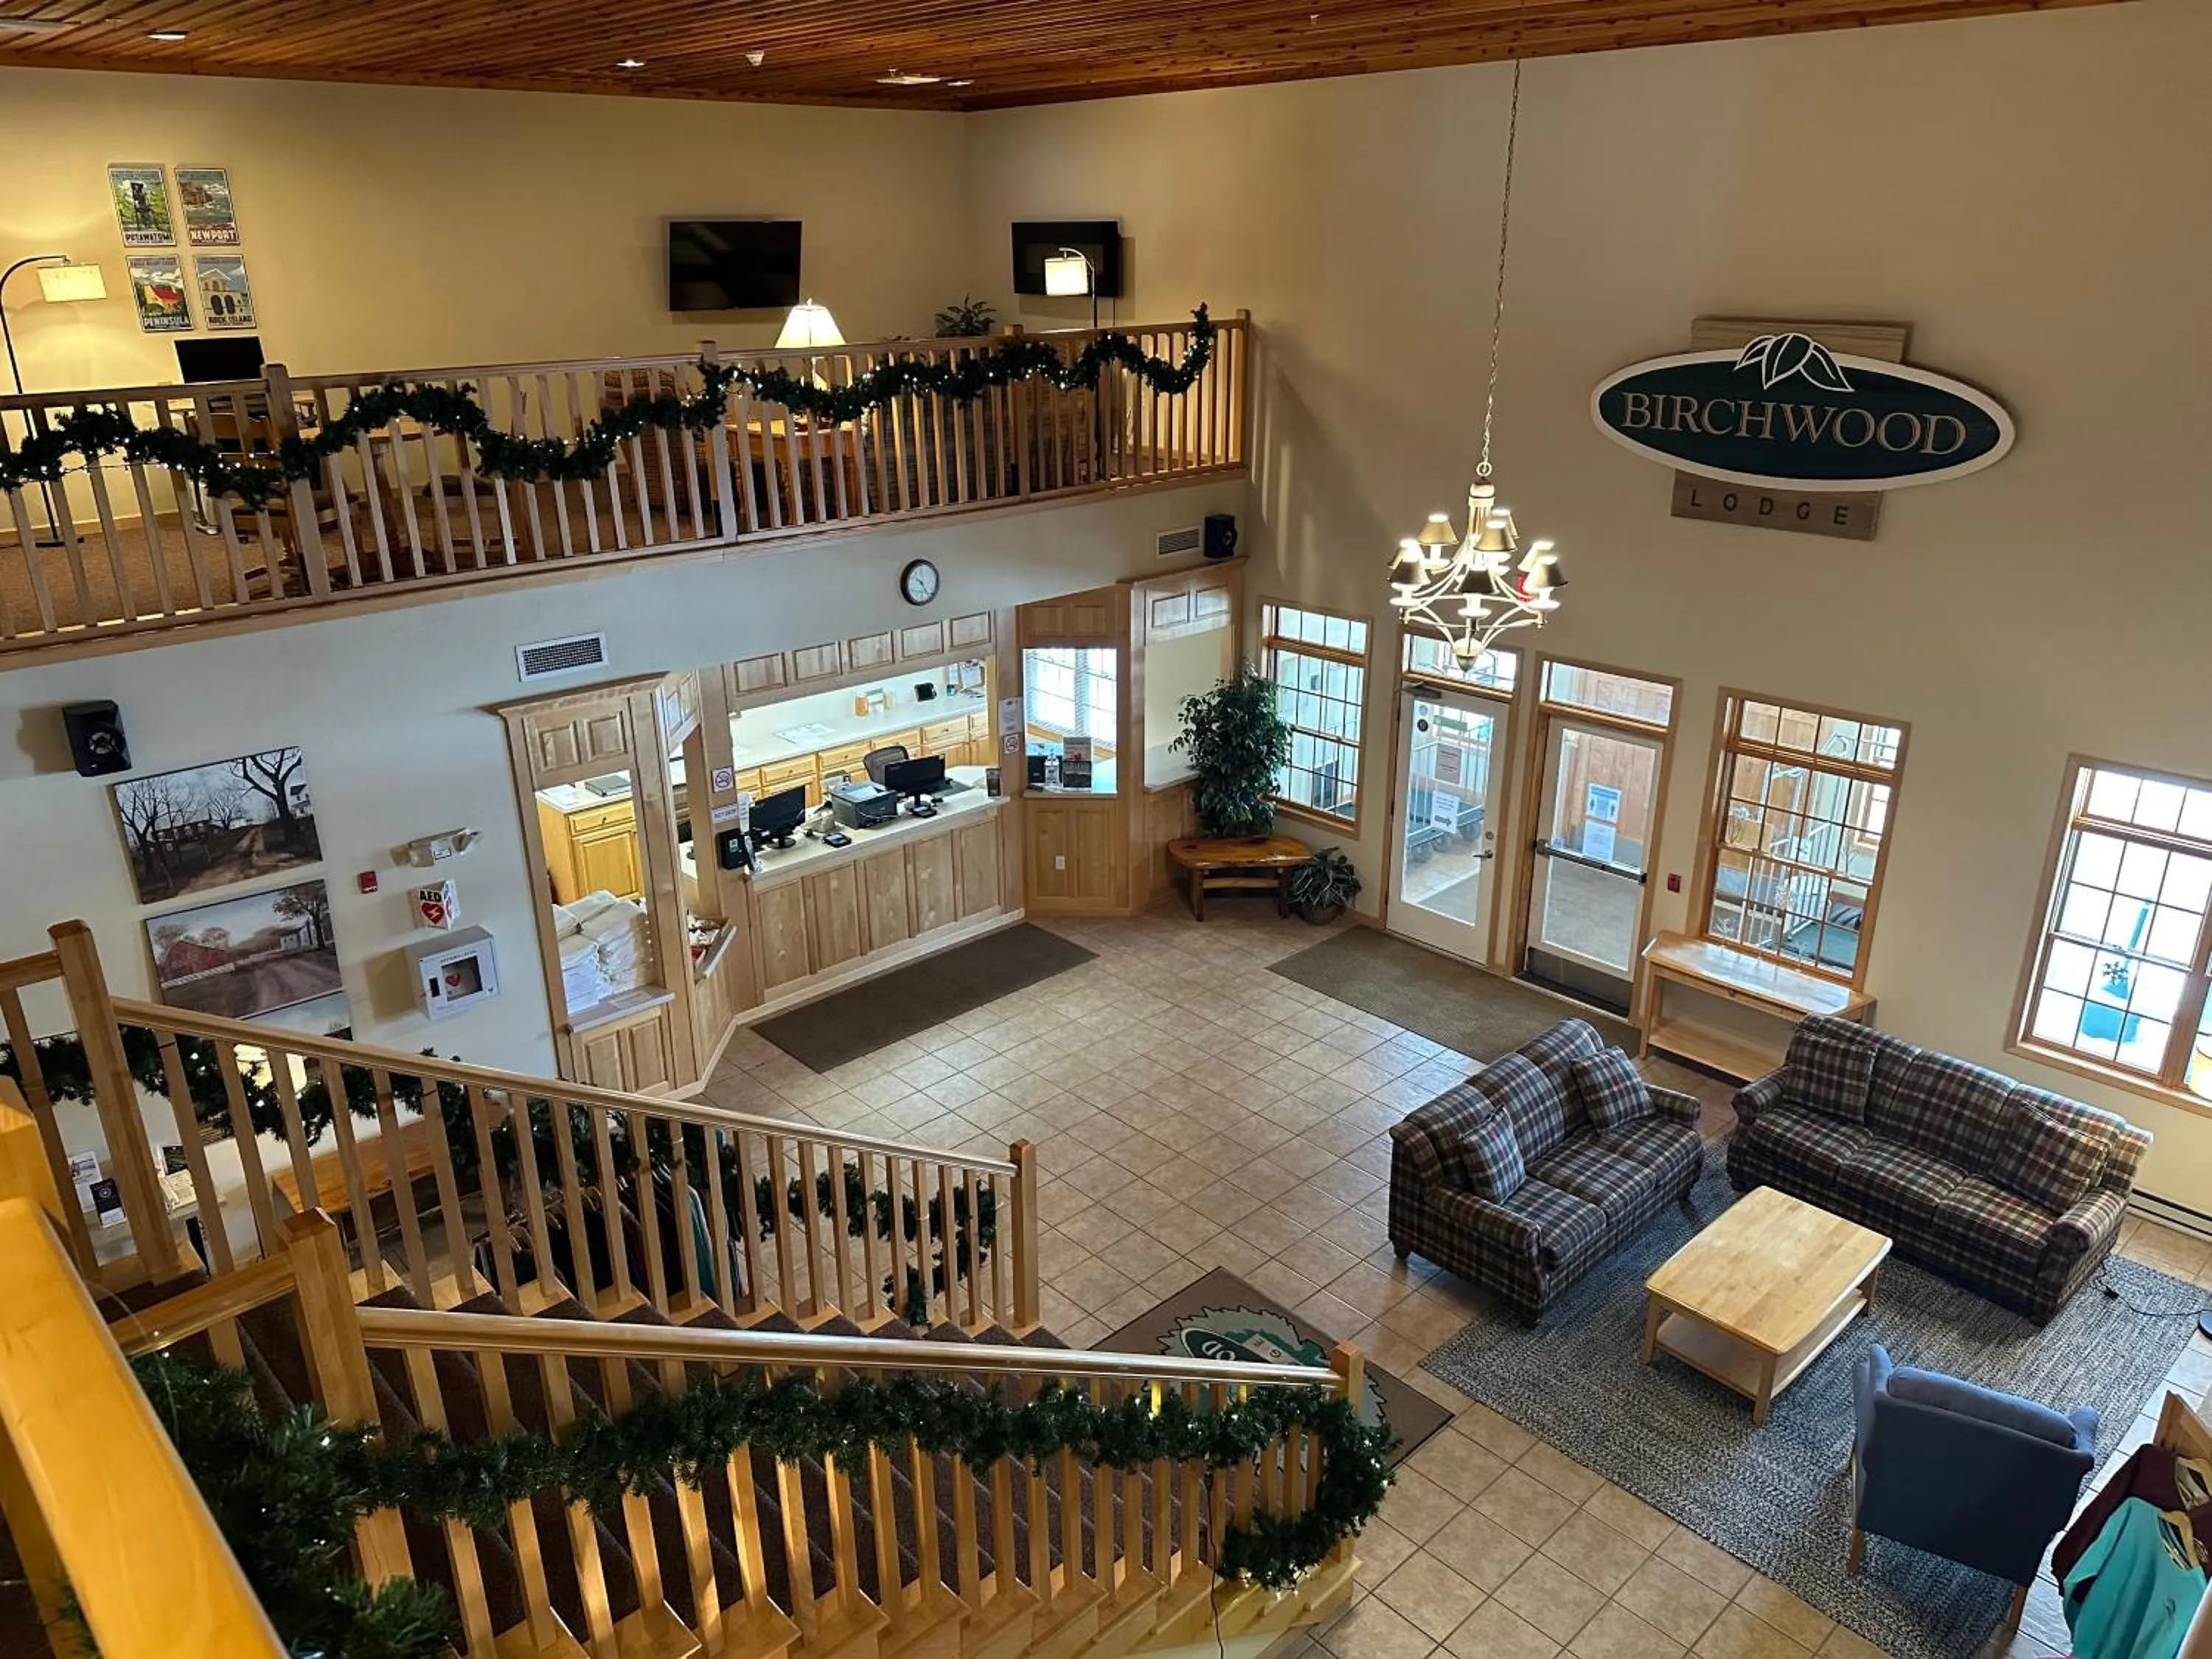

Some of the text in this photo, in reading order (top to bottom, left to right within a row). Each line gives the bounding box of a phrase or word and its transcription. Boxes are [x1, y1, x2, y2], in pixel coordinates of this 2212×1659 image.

[191, 229, 234, 240] NEWPORT
[143, 317, 189, 326] PENINSULA
[1621, 392, 1967, 455] BIRCHWOOD
[1691, 490, 1849, 525] LODGE
[420, 890, 442, 902] AED
